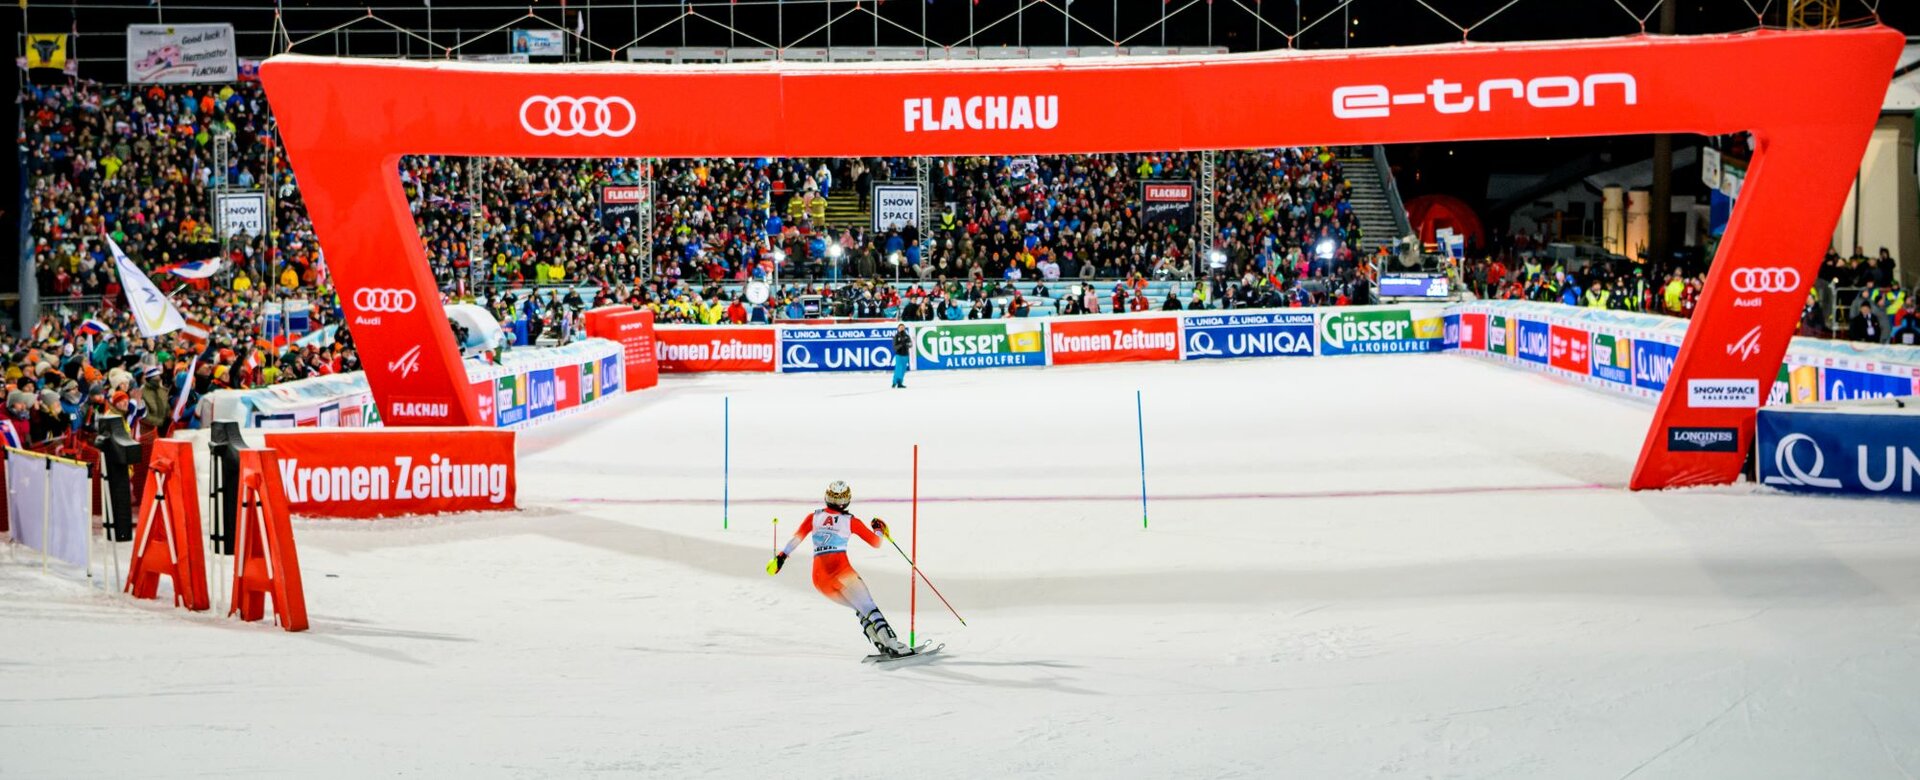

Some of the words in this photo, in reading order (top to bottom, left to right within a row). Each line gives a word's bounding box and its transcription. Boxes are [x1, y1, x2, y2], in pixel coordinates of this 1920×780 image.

[182, 34, 202, 45] Good
[182, 48, 228, 62] Herminator
[191, 65, 228, 77] FLACHAU
[1332, 73, 1637, 119] e-tron
[904, 95, 1059, 132] FLACHAU
[1150, 188, 1188, 198] FLACHAU
[882, 198, 915, 206] SNOW
[882, 212, 914, 220] SPACE
[1733, 297, 1762, 307] Audi
[355, 316, 381, 326] Audi
[1196, 318, 1224, 326] UNIQA
[1241, 316, 1269, 324] UNIQA
[1285, 315, 1313, 323] UNIQA
[838, 330, 865, 338] UNIQA
[1320, 311, 1409, 349] Gösser
[916, 326, 1005, 363] Gösser
[1053, 332, 1112, 353] Kronen
[1112, 328, 1176, 351] Zeitung
[1228, 332, 1313, 354] UNIQA
[1351, 340, 1430, 353] ALKOHOLFREI
[655, 340, 709, 361] Kronen
[711, 338, 773, 363] Zeitung
[947, 354, 1026, 368] ALKOHOLFREI
[1693, 386, 1725, 394] SNOW
[1726, 386, 1755, 394] SPACE
[392, 402, 449, 417] FLACHAU
[1674, 431, 1733, 442] LONGINES
[278, 458, 390, 503] Kronen
[395, 453, 508, 504] Zeitung
[823, 515, 839, 526] A1
[823, 532, 833, 545] 7
